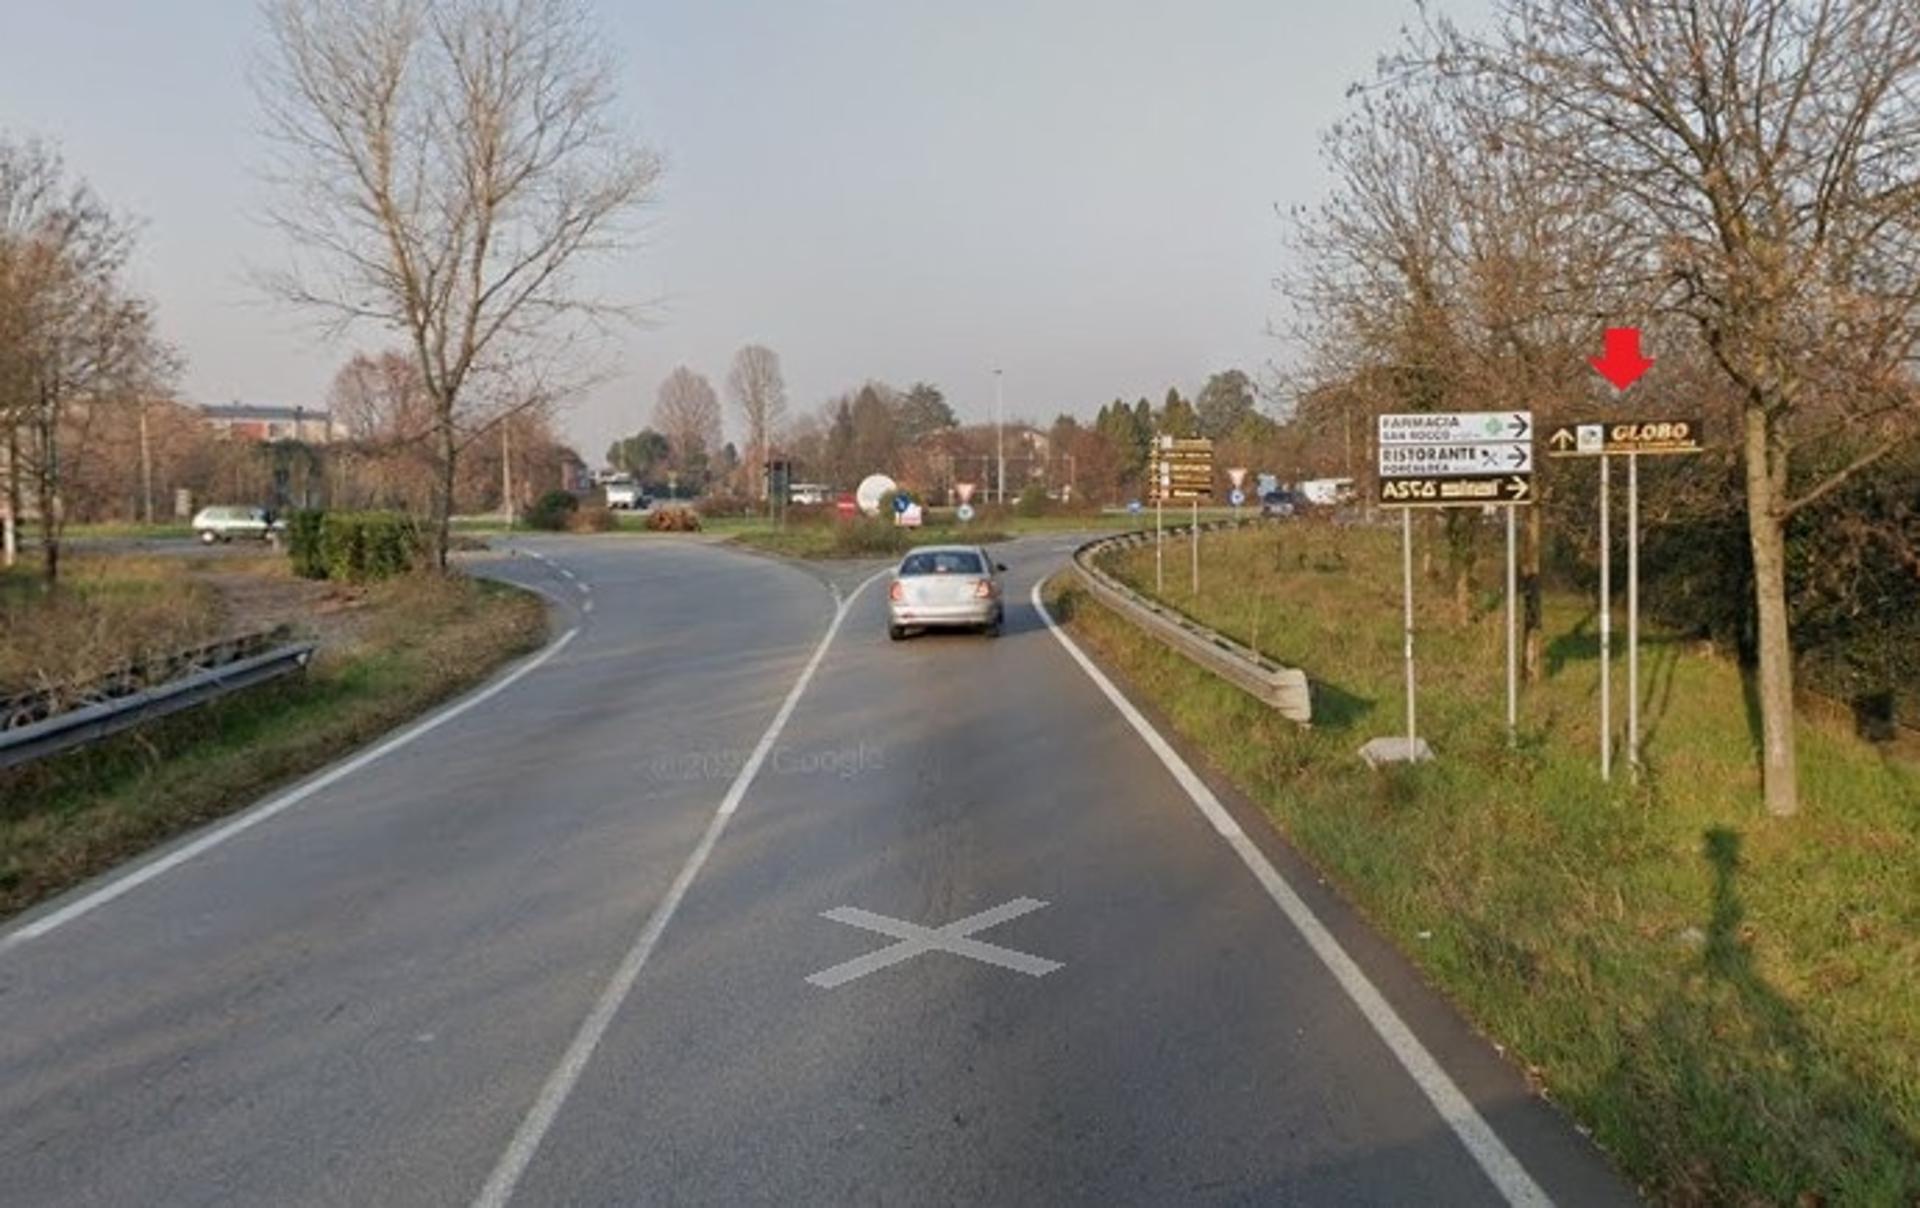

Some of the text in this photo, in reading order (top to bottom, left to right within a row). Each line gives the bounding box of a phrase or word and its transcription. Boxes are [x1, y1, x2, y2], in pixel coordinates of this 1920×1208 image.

[1382, 416, 1459, 429] FARMACIA
[1611, 423, 1689, 441] GLOBO
[1382, 447, 1476, 462] RISTORANTE
